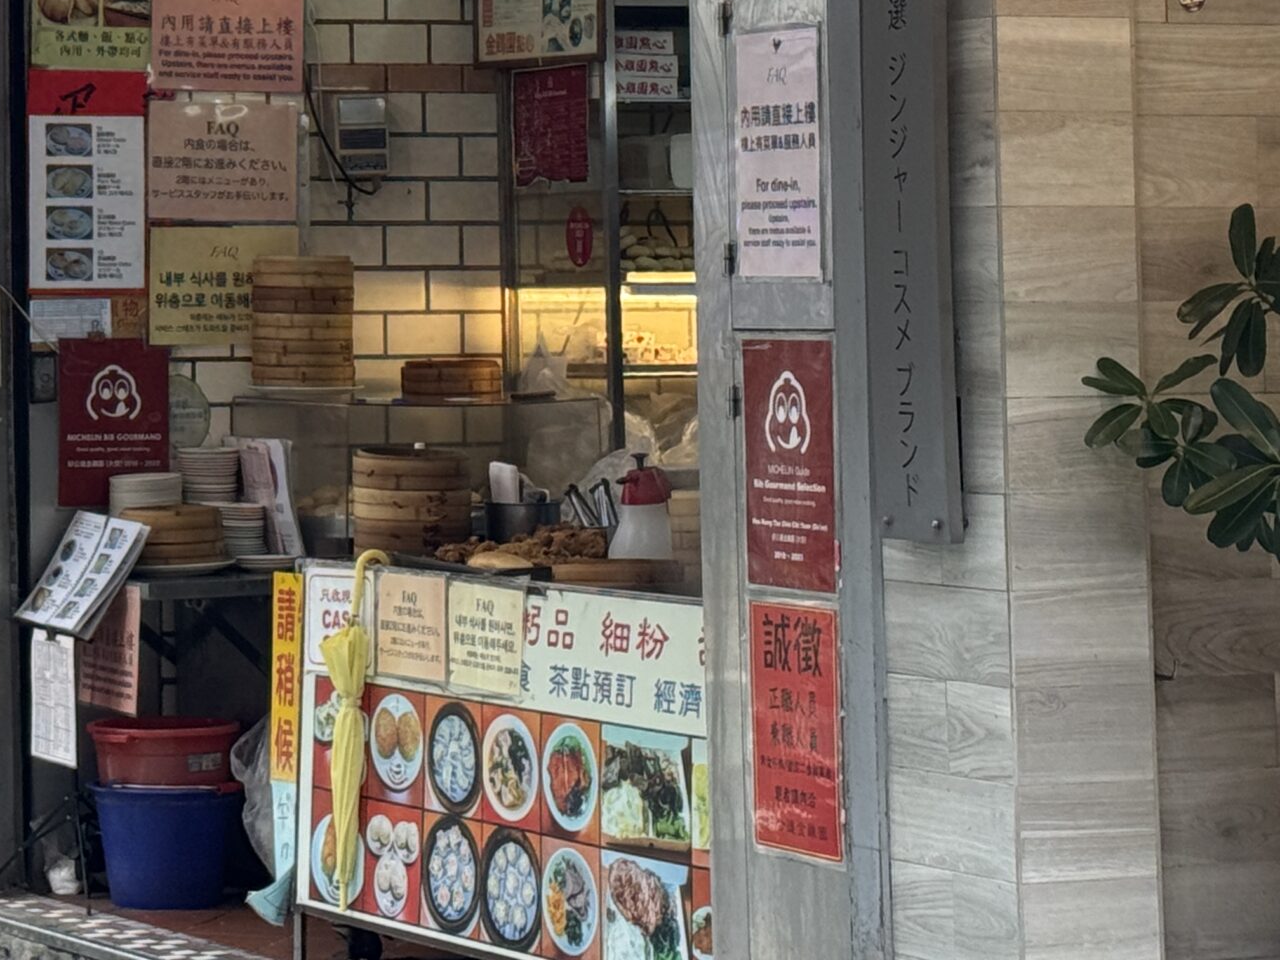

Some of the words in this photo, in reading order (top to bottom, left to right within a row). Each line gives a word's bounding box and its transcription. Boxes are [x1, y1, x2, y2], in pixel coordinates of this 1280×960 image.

[206, 121, 240, 138] FAQ
[756, 178, 769, 193] For
[402, 590, 418, 606] FAQ
[476, 598, 495, 617] FAQ
[599, 611, 670, 661] 細粉
[762, 613, 823, 677] 誠徵
[275, 588, 295, 772] 請稍候
[549, 664, 636, 708] 茶點預訂
